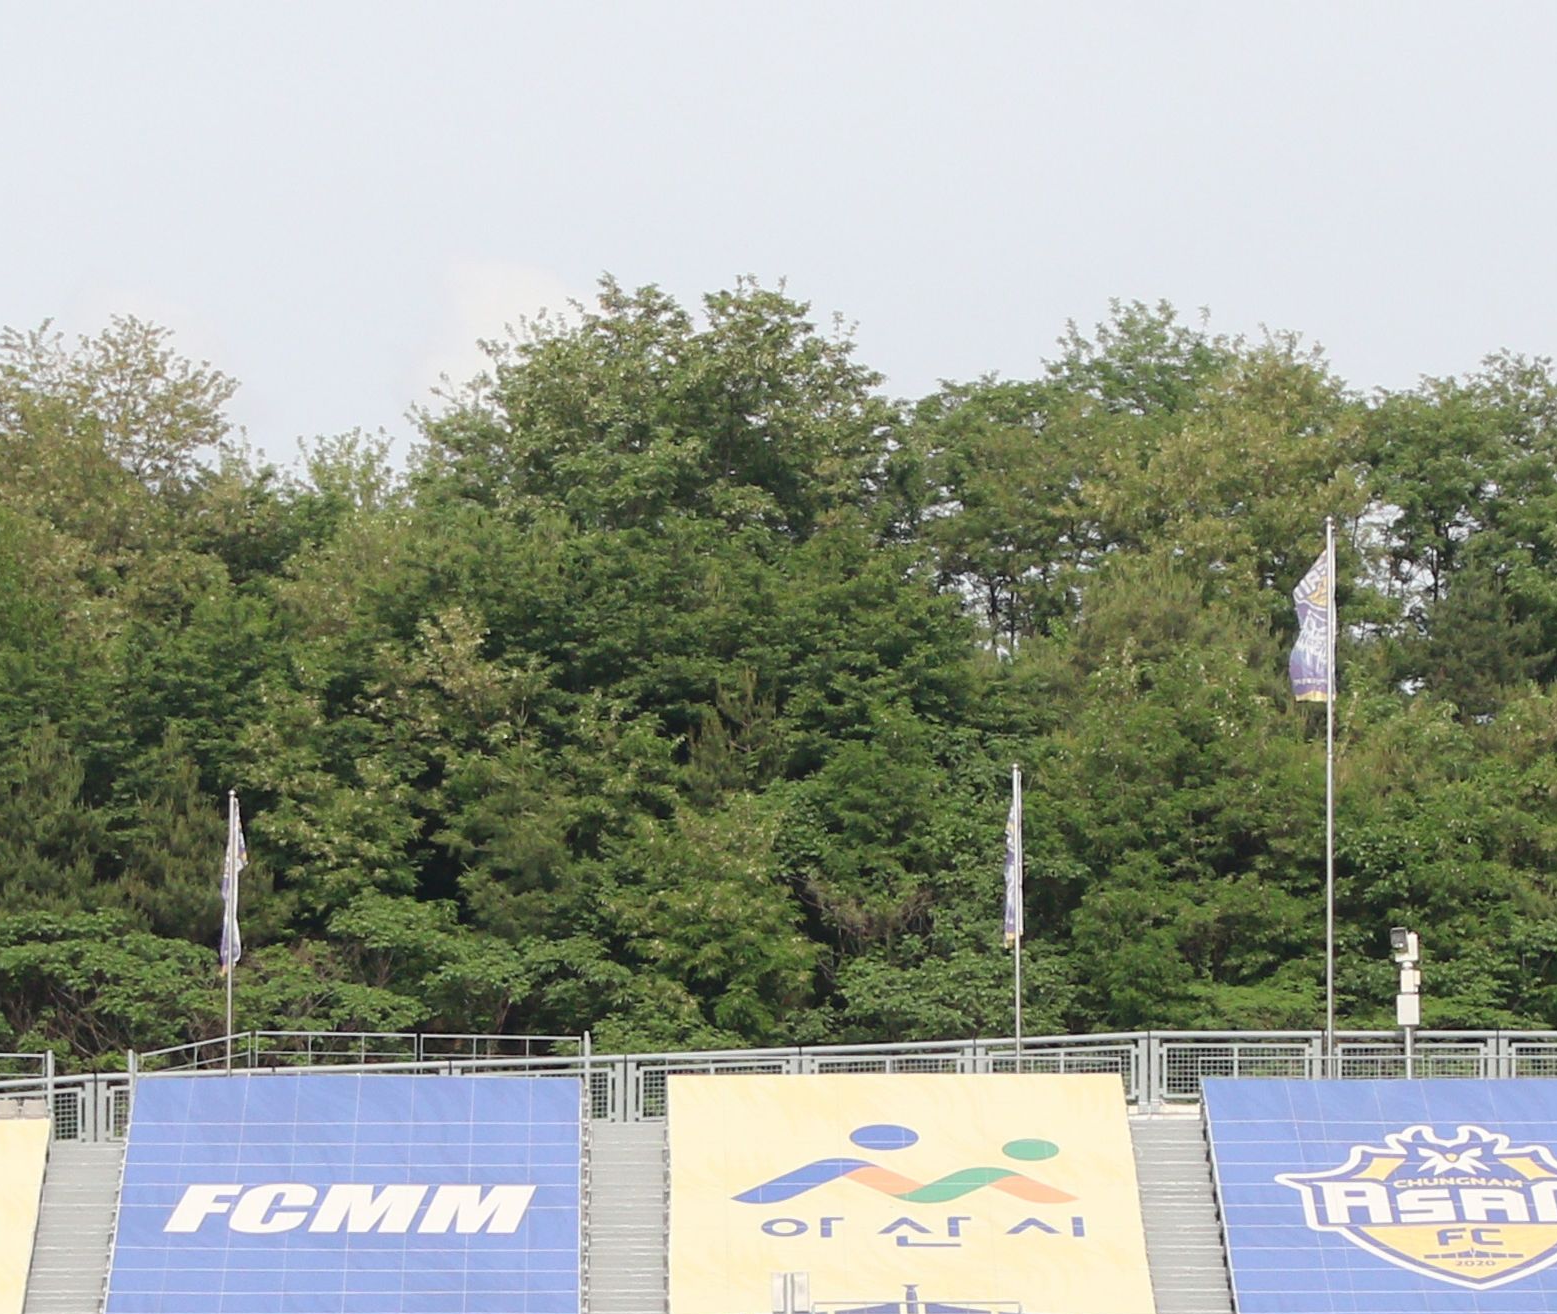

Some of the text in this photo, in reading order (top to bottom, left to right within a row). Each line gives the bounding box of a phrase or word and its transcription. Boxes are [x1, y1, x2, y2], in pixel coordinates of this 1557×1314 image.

[1393, 1176, 1524, 1188] CHUNGNAM
[163, 1183, 537, 1234] FCMM
[760, 1216, 1086, 1248] 아산시
[1436, 1227, 1505, 1247] FC
[1454, 1259, 1497, 1267] 2020
